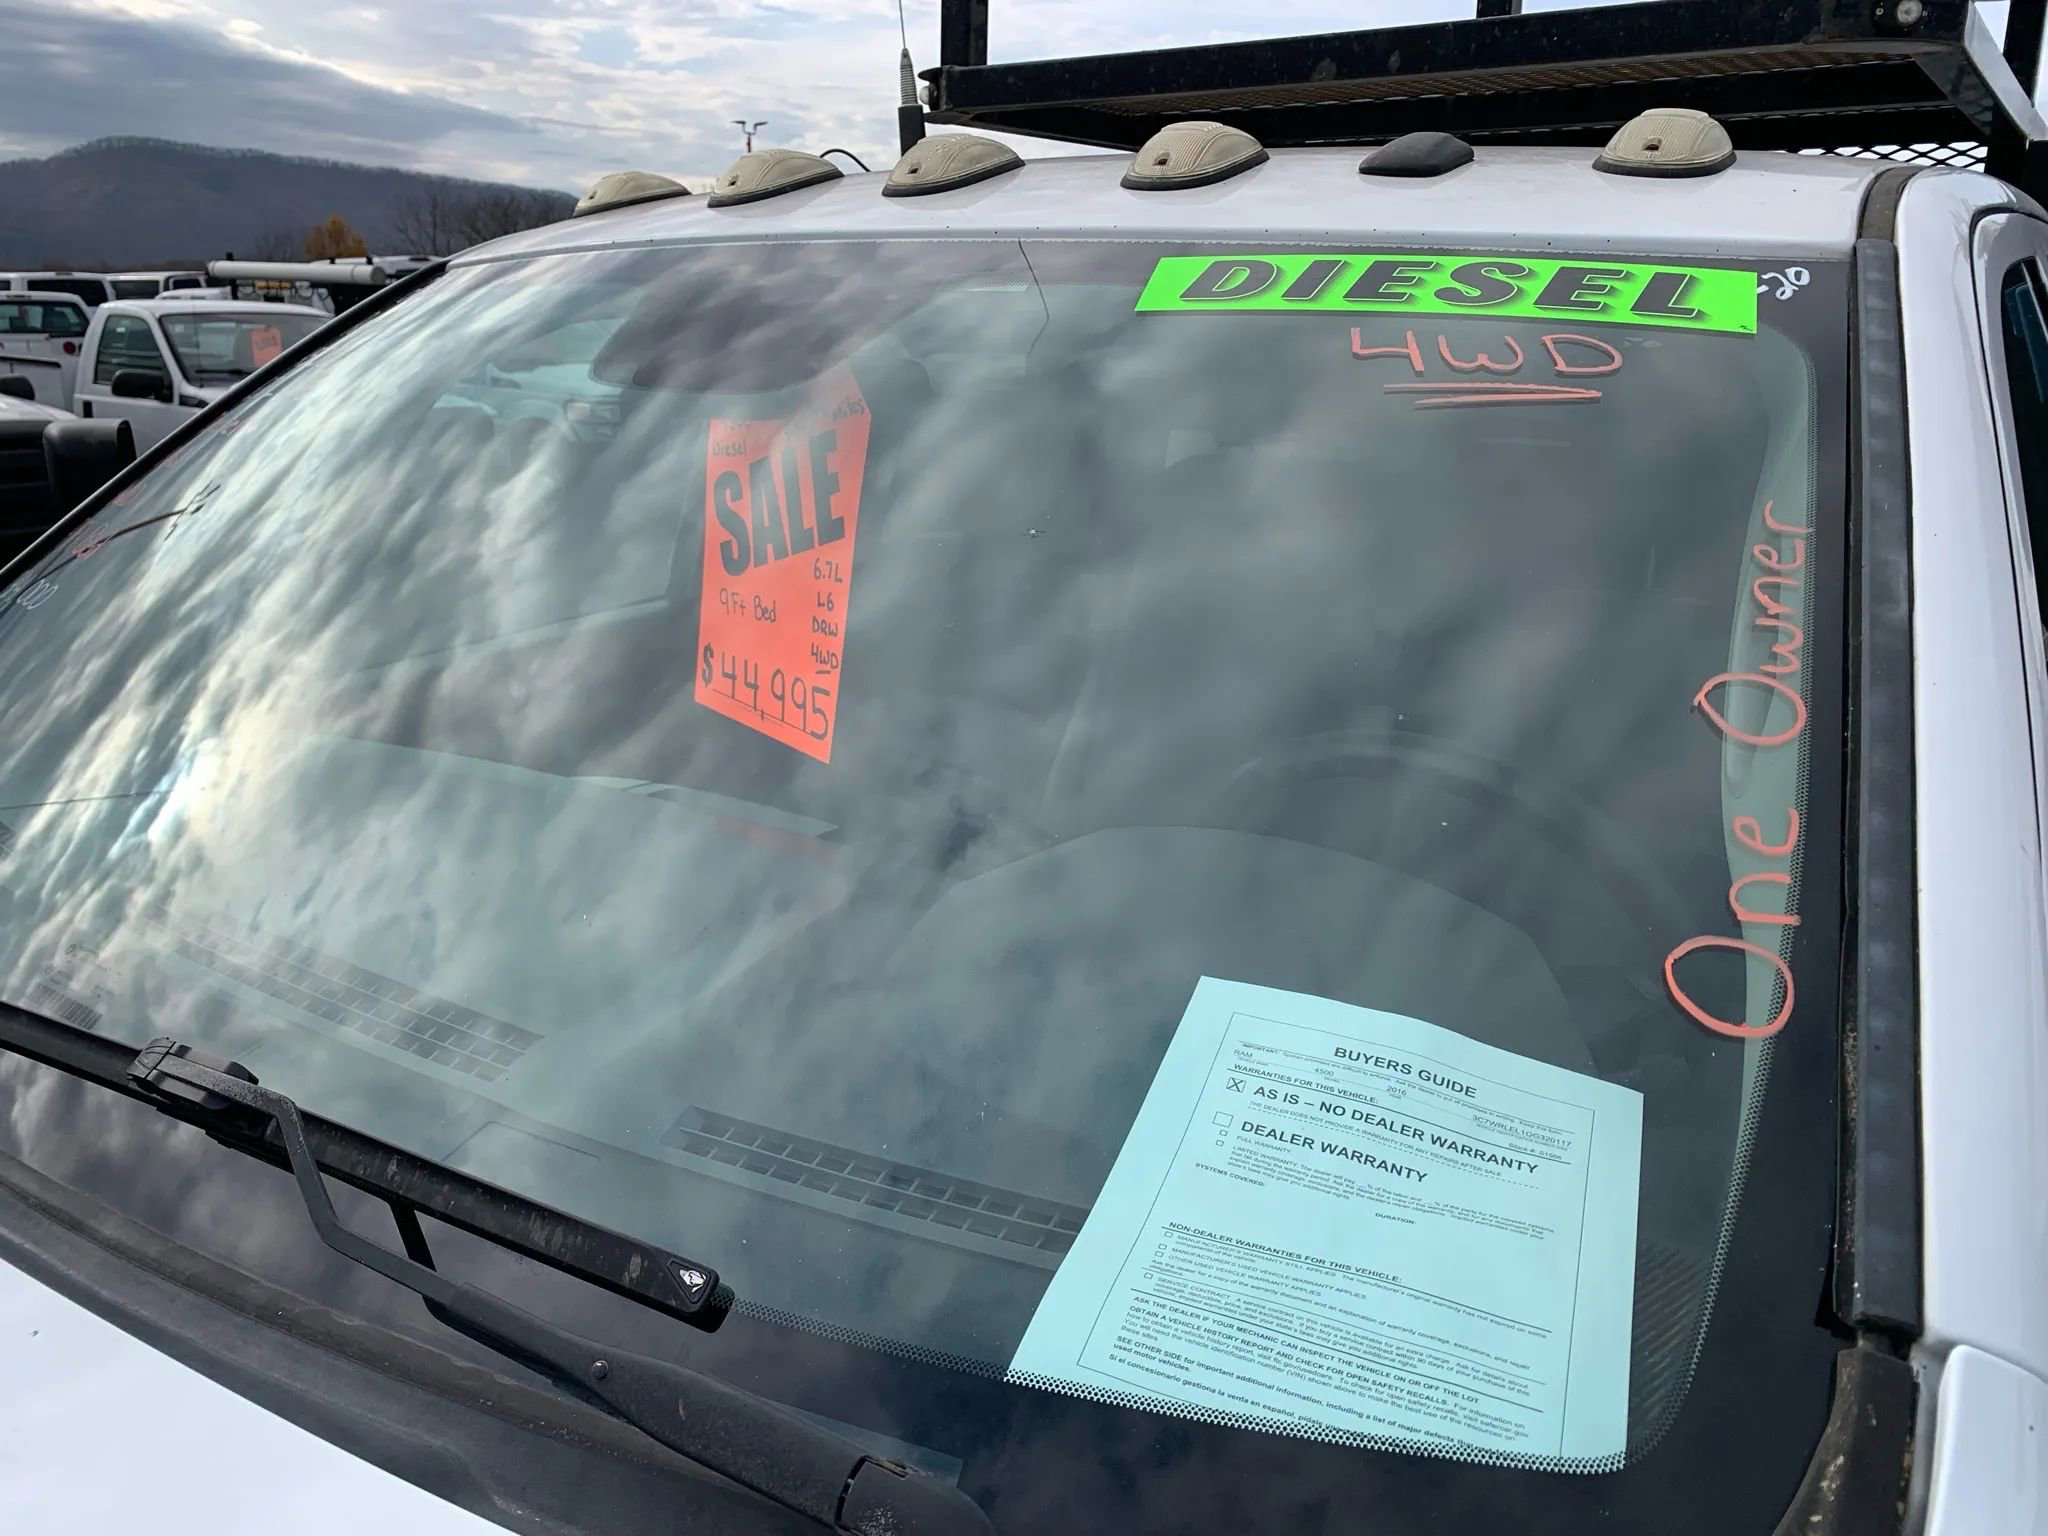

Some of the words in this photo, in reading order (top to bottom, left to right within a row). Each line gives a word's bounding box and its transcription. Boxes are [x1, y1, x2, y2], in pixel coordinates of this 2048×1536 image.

[1179, 260, 1705, 318] DIESEL
[1350, 327, 1623, 374] 4WD
[711, 435, 748, 458] Diesel
[713, 430, 846, 576] SALE
[813, 557, 843, 583] 6.7L
[753, 594, 777, 623] Bed
[816, 590, 835, 612] L6
[812, 615, 839, 637] DRW
[1692, 499, 1815, 746] Owner
[810, 642, 840, 670] 4WD
[1664, 808, 1802, 1040] One
[1234, 1049, 1253, 1058] RAM
[1314, 1067, 1335, 1076] 4500
[1334, 1046, 1412, 1075] BUYERS
[1418, 1069, 1476, 1098] GUIDE
[1234, 1063, 1292, 1082] WARRANTIES
[1294, 1078, 1312, 1086] FOR
[1316, 1083, 1335, 1092] THIS
[1337, 1089, 1378, 1103] VEHICLE:
[1387, 1085, 1407, 1095] 2016
[1237, 1135, 1253, 1143] FULL
[1254, 1085, 1279, 1099] AS
[1283, 1092, 1300, 1105] IS
[1319, 1101, 1346, 1117] NO
[1351, 1109, 1425, 1141] DEALER
[1430, 1134, 1538, 1174] WARRANTY
[1263, 1104, 1289, 1114] DEALER
[1290, 1111, 1308, 1119] DOES
[1325, 1120, 1353, 1130] PROVIDE
[1361, 1129, 1398, 1145] WARRANTY
[1400, 1142, 1414, 1150] FOR
[1416, 1146, 1428, 1154] ANY
[1431, 1151, 1459, 1164] REPAIRS
[1196, 1162, 1228, 1176] SYSTEMS
[1241, 1121, 1316, 1149] DEALER
[1320, 1142, 1427, 1183] WARRANTY
[1168, 1254, 1193, 1264] OTHER
[1194, 1260, 1214, 1269] USED
[1216, 1265, 1246, 1277] VEHICLE
[1248, 1273, 1289, 1287] WARRANTY
[1169, 1222, 1233, 1242] NON-DEALER
[1235, 1239, 1302, 1259] WARRANTIES
[1305, 1255, 1326, 1264] FOR
[1329, 1261, 1352, 1270] THIS
[1355, 1266, 1402, 1282] VEHICLE:
[1238, 1263, 1258, 1271] USED
[1260, 1268, 1289, 1279] VEHICLE
[1292, 1275, 1333, 1290] WARRANTY
[1113, 1343, 1133, 1352] used
[1134, 1348, 1157, 1360] motor
[1159, 1356, 1192, 1371] vehicles.
[1130, 1305, 1159, 1317] OBTAIN
[1169, 1316, 1202, 1330] VEHICLE
[1204, 1327, 1239, 1342] HISTORY
[1241, 1338, 1276, 1353] REPORT
[1277, 1349, 1293, 1359] AND
[1296, 1356, 1324, 1369] CHECK
[1327, 1366, 1344, 1375] FOR
[1346, 1372, 1369, 1383] OPEN
[1372, 1379, 1404, 1393] SAFETY
[1134, 1295, 1150, 1304] ASK
[1152, 1300, 1168, 1309] THE
[1169, 1305, 1201, 1319] DEALER
[1212, 1318, 1234, 1329] YOUR
[1237, 1325, 1279, 1343] MECHANIC
[1281, 1339, 1298, 1349] CAN
[1301, 1345, 1335, 1360] INSPECT
[1338, 1357, 1353, 1366] THE
[1356, 1363, 1391, 1378] VEHICLE
[1394, 1374, 1406, 1382] ON
[1409, 1378, 1420, 1386] OR
[1424, 1382, 1440, 1391] OFF
[1443, 1387, 1459, 1397] THE
[1117, 1335, 1133, 1344] SEE
[1135, 1340, 1162, 1354] OTHER
[1164, 1350, 1183, 1360] SIDE
[1184, 1356, 1195, 1364] for
[1196, 1360, 1234, 1378] important
[1236, 1372, 1274, 1389] additional
[1276, 1385, 1324, 1407] information,
[1326, 1401, 1364, 1418] including
[1373, 1414, 1386, 1423] list
[1398, 1421, 1422, 1435] major
[1424, 1429, 1454, 1442] defects
[1127, 1359, 1182, 1382] concesionario
[1182, 1377, 1217, 1394] gestiona
[1228, 1391, 1249, 1403] venta
